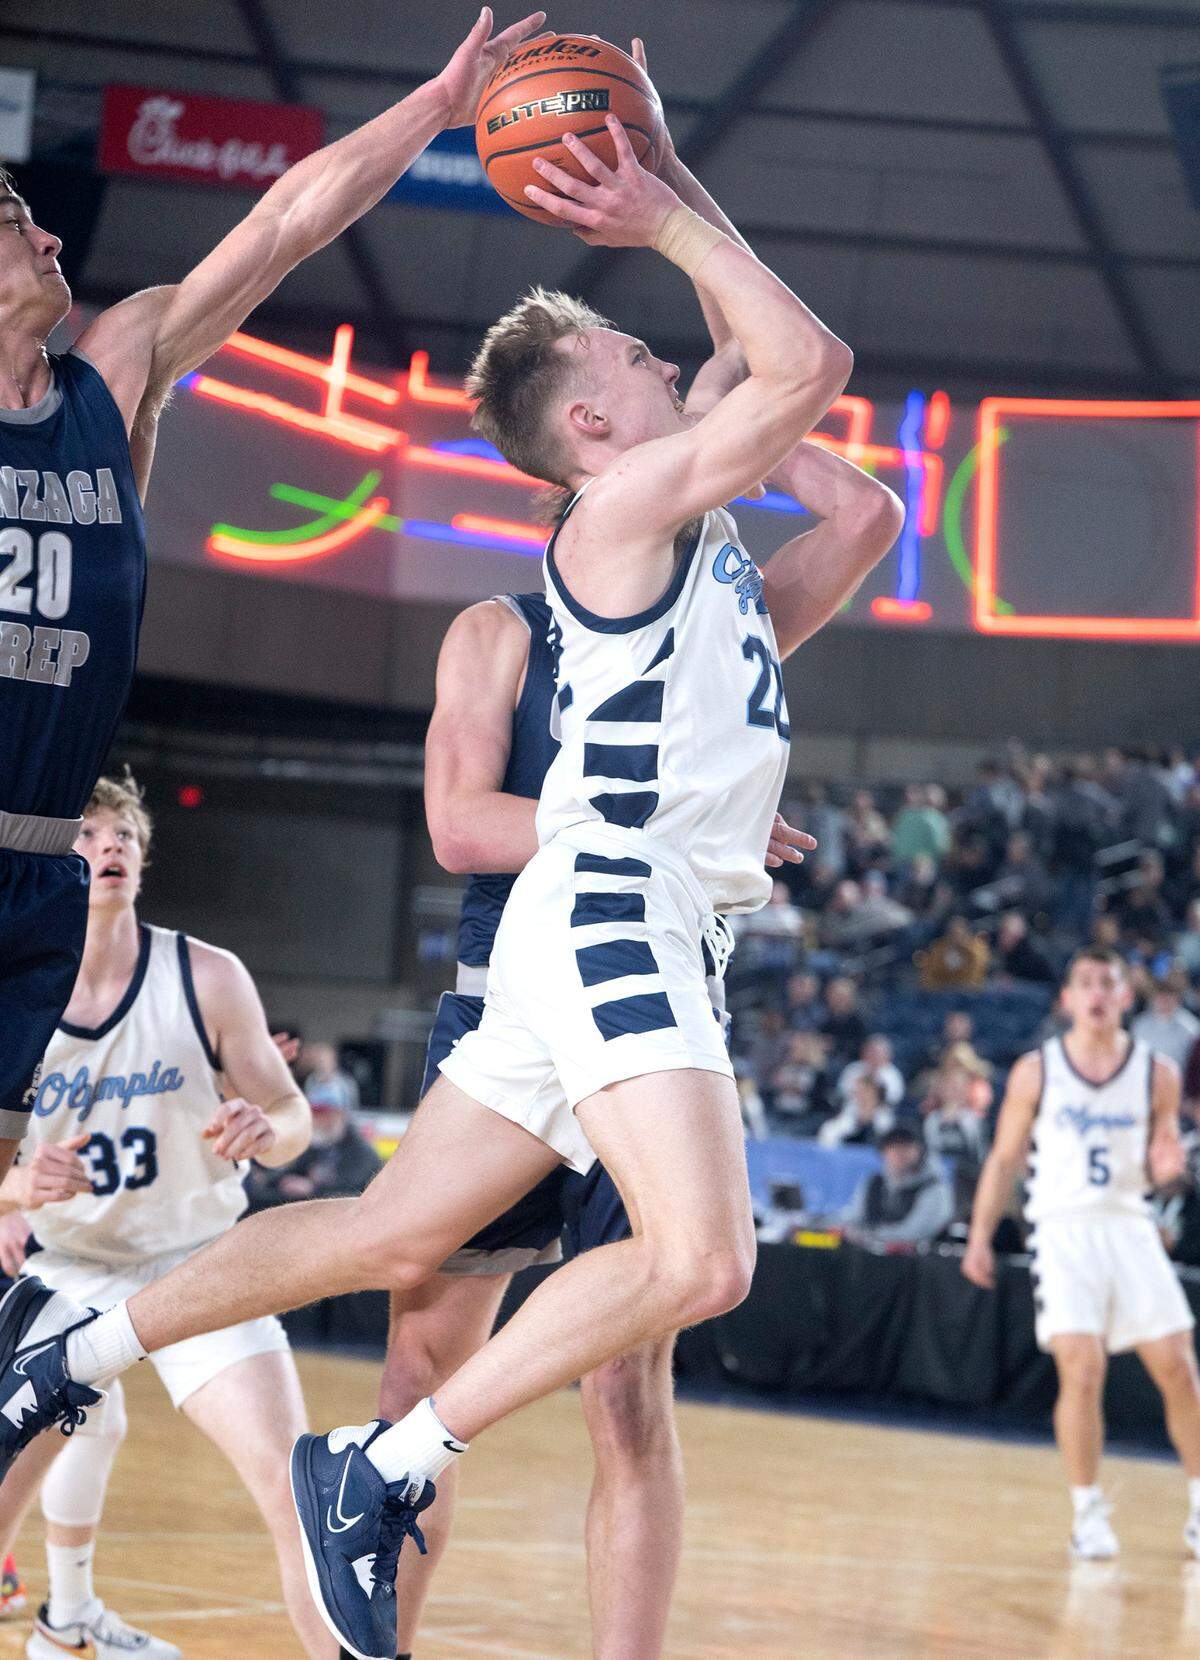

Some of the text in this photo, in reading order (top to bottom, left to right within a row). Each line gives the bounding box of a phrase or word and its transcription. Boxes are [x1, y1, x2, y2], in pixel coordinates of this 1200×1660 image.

[486, 89, 610, 135] ELITE PRO
[0, 526, 73, 621] 20
[34, 1060, 184, 1122] Olympia
[78, 1126, 159, 1196] 33
[1088, 1145, 1112, 1188] 5
